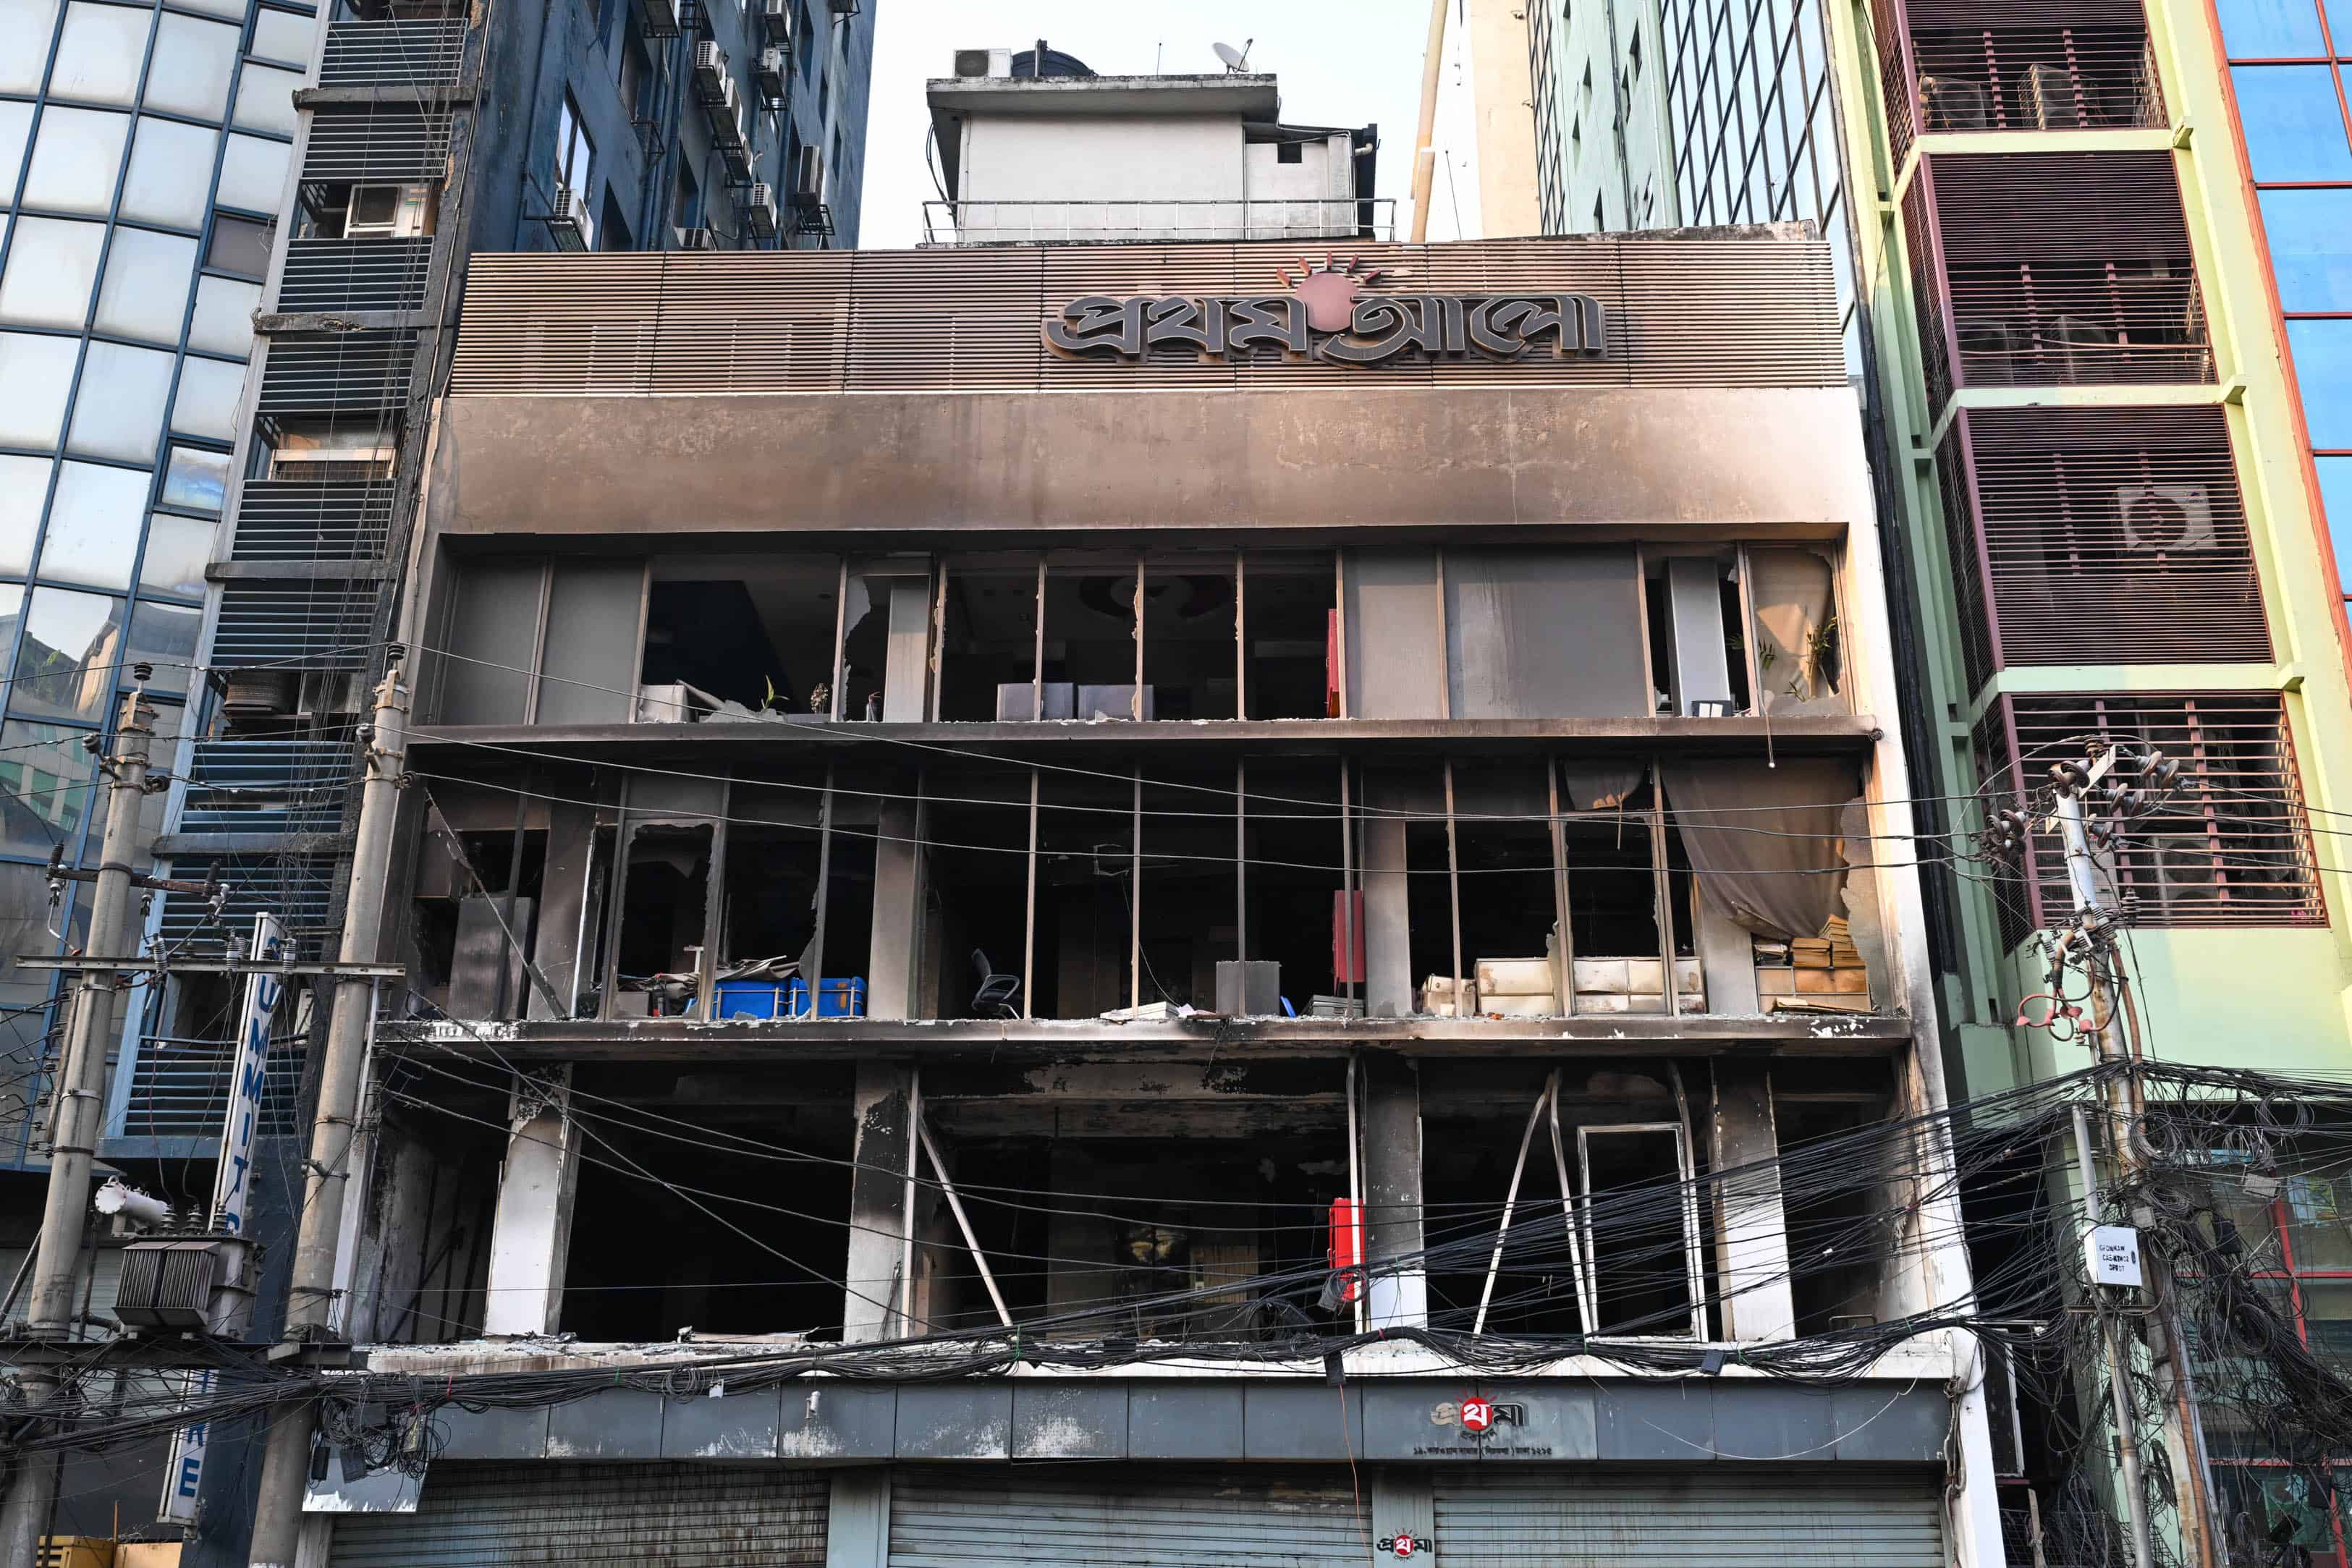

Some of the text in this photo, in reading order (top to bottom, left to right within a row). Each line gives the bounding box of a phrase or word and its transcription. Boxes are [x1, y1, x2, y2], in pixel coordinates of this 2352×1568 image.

[1043, 295, 1606, 363] প্রথম আলো
[1376, 1538, 1432, 1553] প্রথমা
